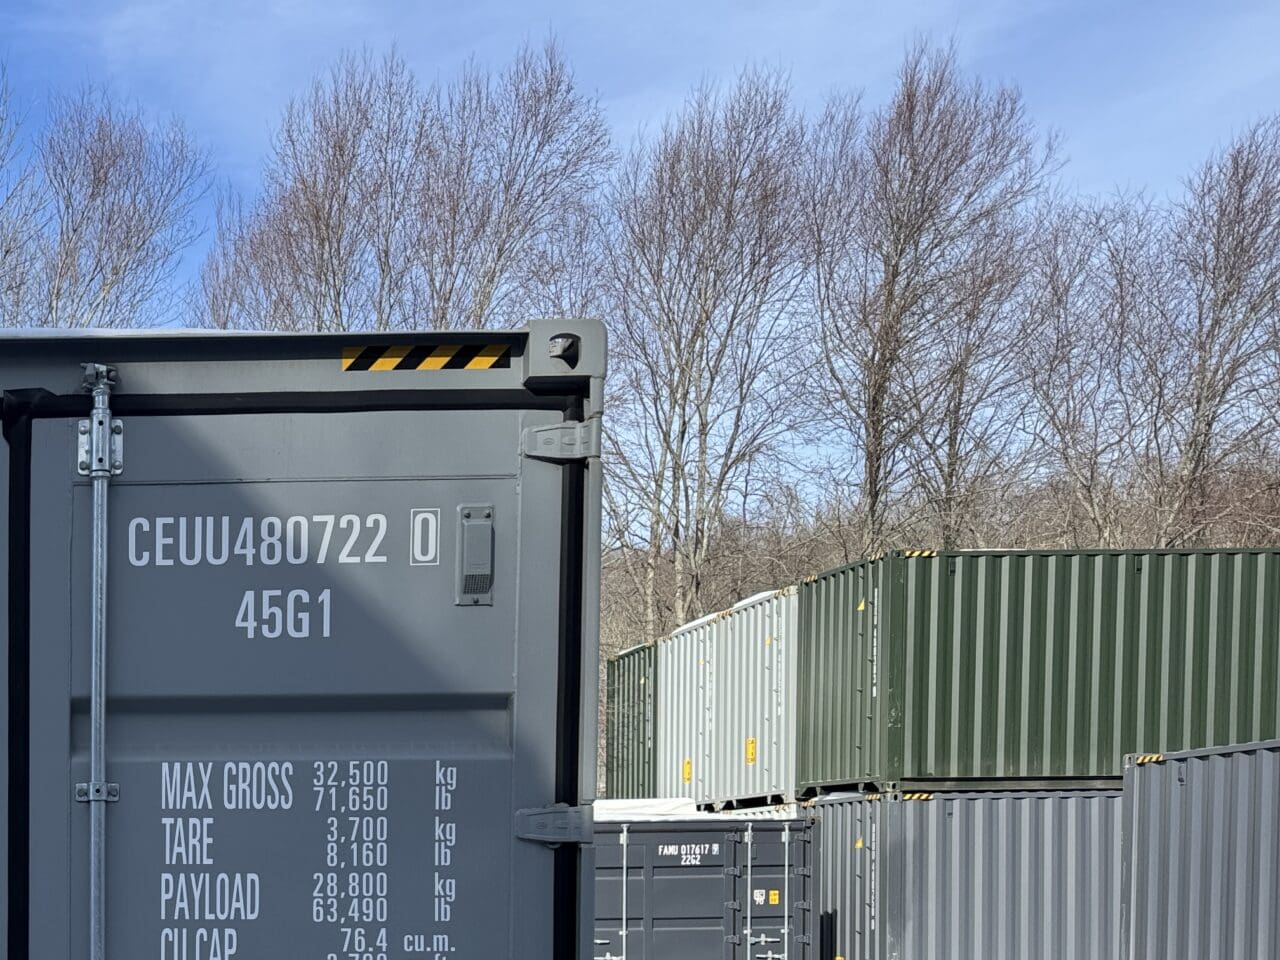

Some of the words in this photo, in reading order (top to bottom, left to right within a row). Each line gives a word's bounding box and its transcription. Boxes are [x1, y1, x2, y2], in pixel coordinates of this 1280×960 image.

[128, 513, 388, 566] CEUU480722
[413, 511, 437, 562] 0
[235, 589, 331, 639] 45G1
[161, 762, 213, 810] MAX
[223, 762, 293, 810] GROSS
[312, 760, 388, 787] 32,500
[435, 760, 457, 790] kg
[313, 786, 388, 813] 71,650
[435, 786, 451, 810] lb
[161, 817, 214, 865] TARE
[327, 816, 388, 843] 3,700
[434, 816, 456, 846] kg
[326, 842, 388, 868] 8,160
[434, 842, 451, 866] lb
[160, 872, 260, 920] PAYLOAD
[312, 872, 388, 898] 28,800
[434, 872, 456, 902] kg
[312, 897, 388, 924] 63,490
[434, 897, 451, 921] lb
[340, 927, 388, 952] 76.4
[403, 933, 456, 952] cu.m.
